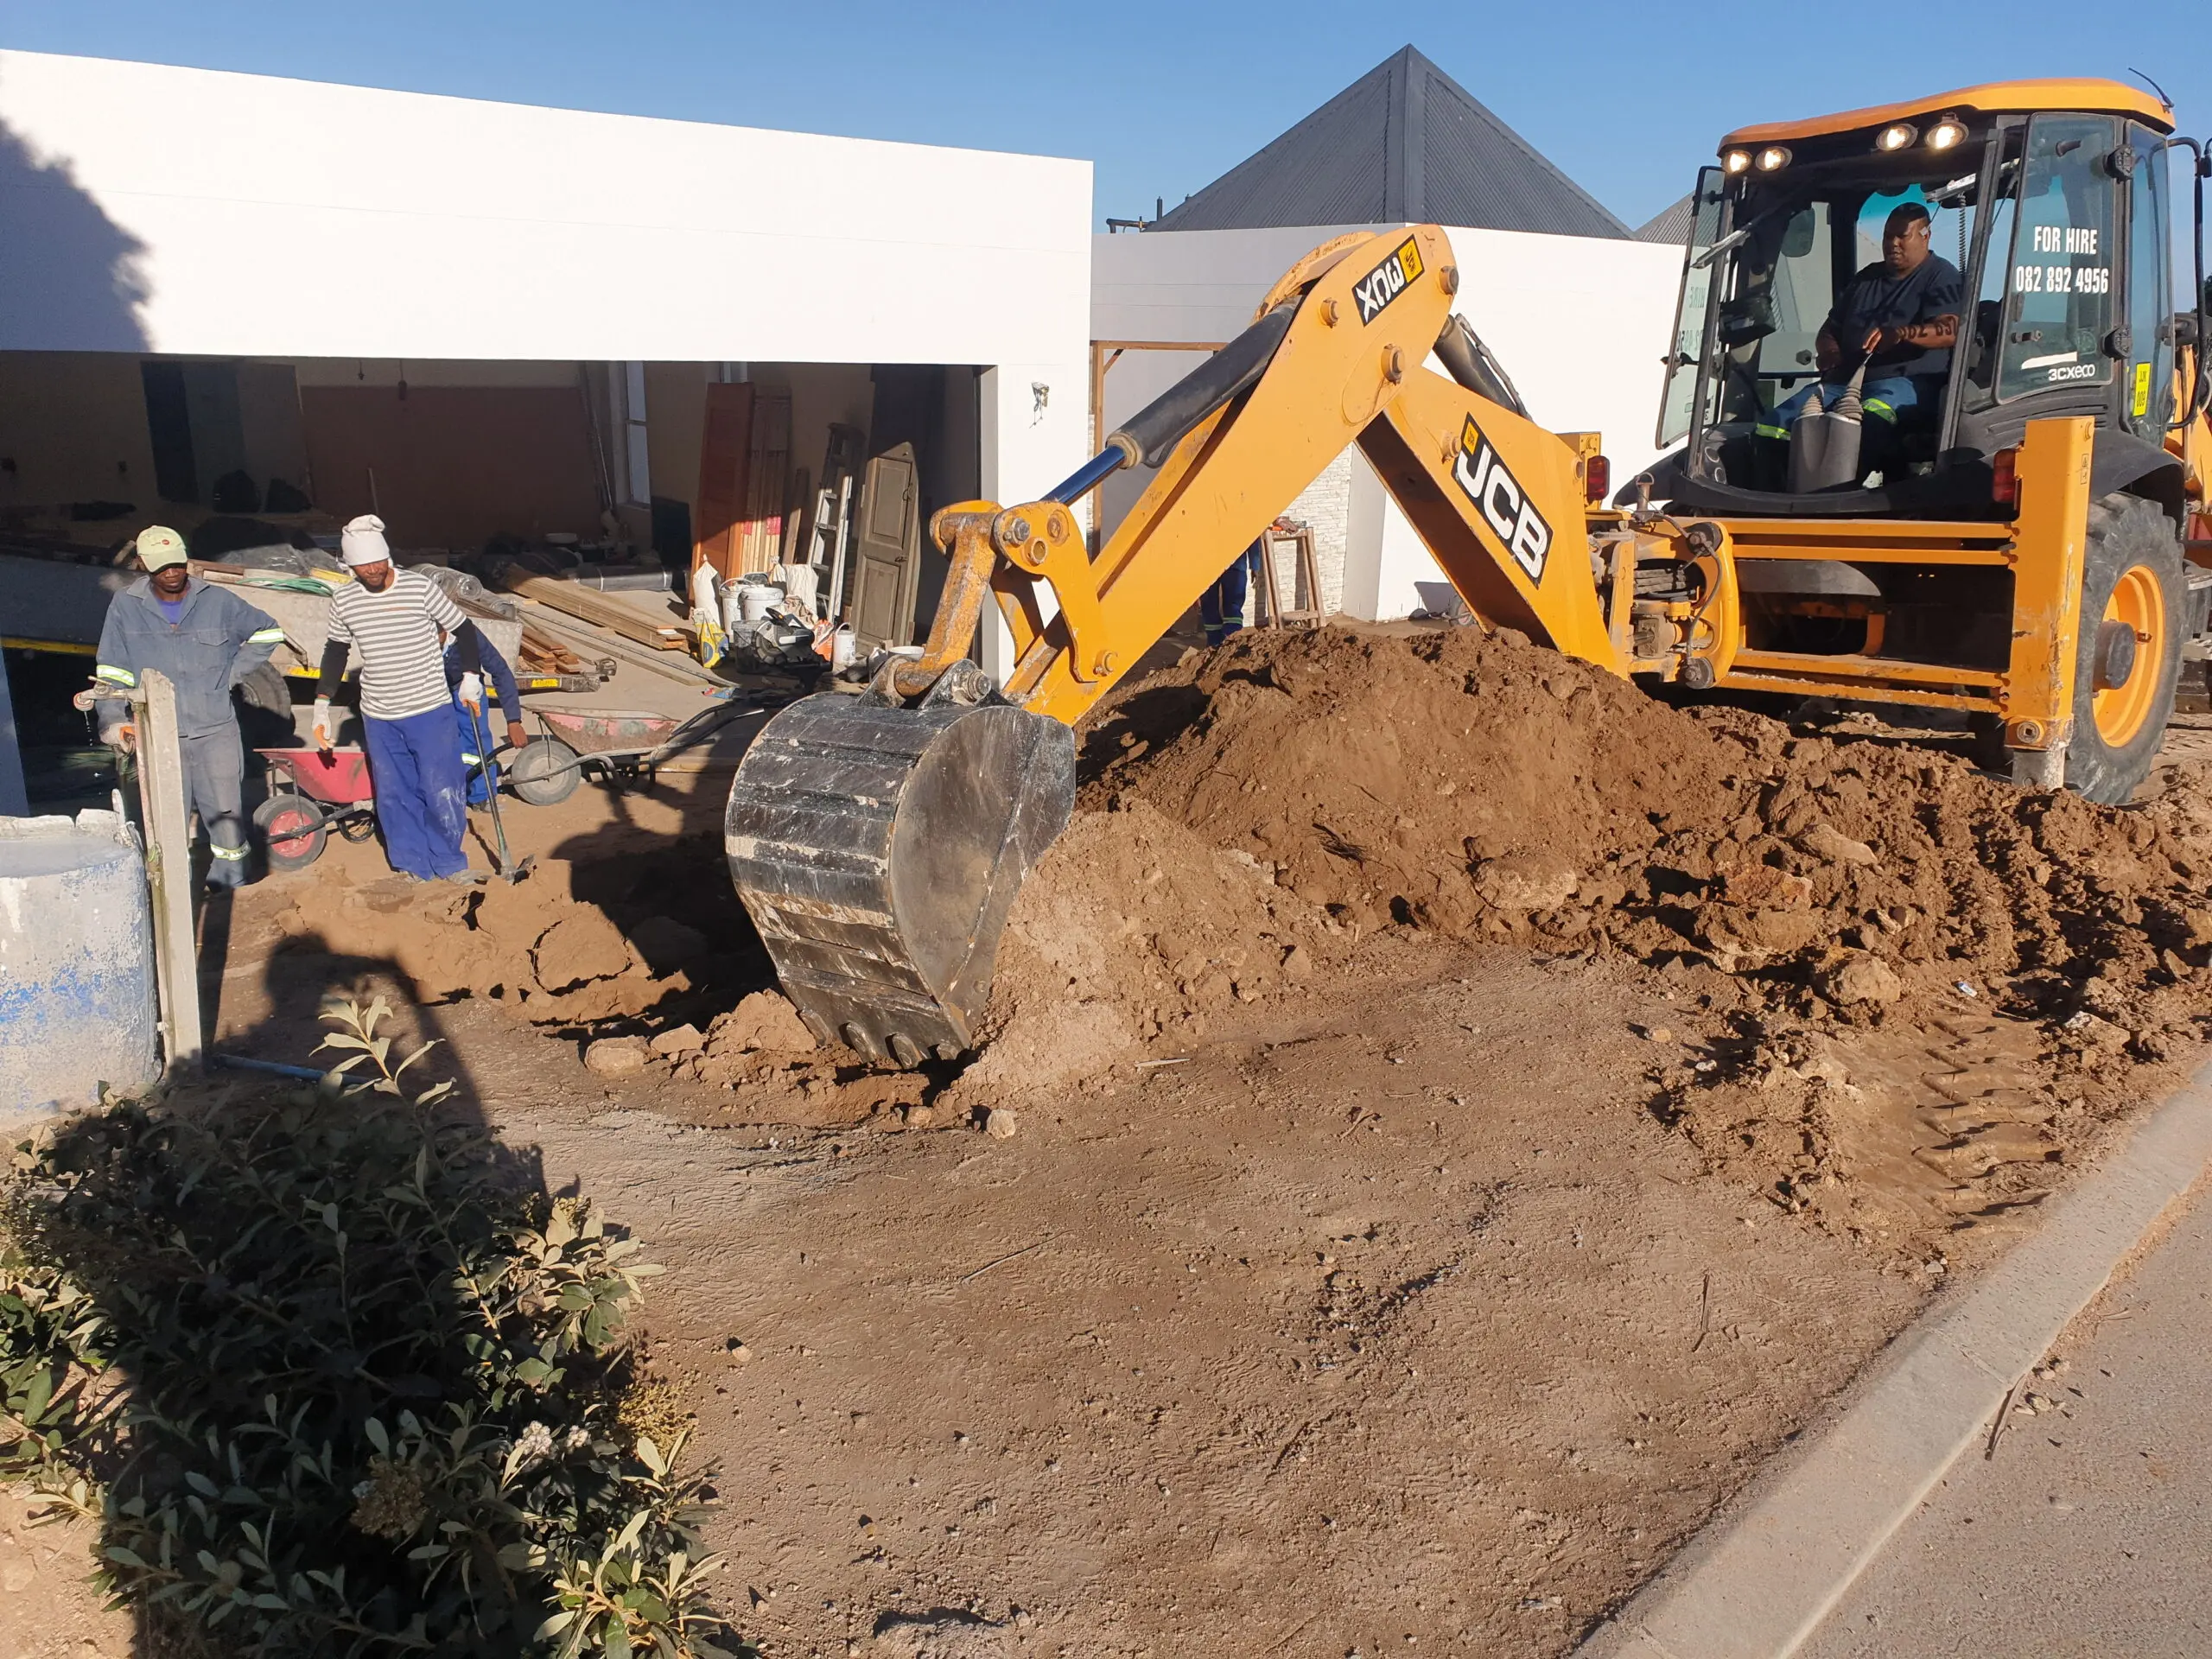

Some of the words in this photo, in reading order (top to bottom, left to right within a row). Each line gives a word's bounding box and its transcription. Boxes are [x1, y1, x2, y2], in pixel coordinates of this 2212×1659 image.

[2033, 226, 2061, 252] FOR
[2065, 227, 2098, 255] HIRE
[2016, 265, 2042, 292] 082
[2046, 266, 2072, 293] 892
[2075, 267, 2109, 294] 4956
[1457, 442, 1548, 578] JCB
